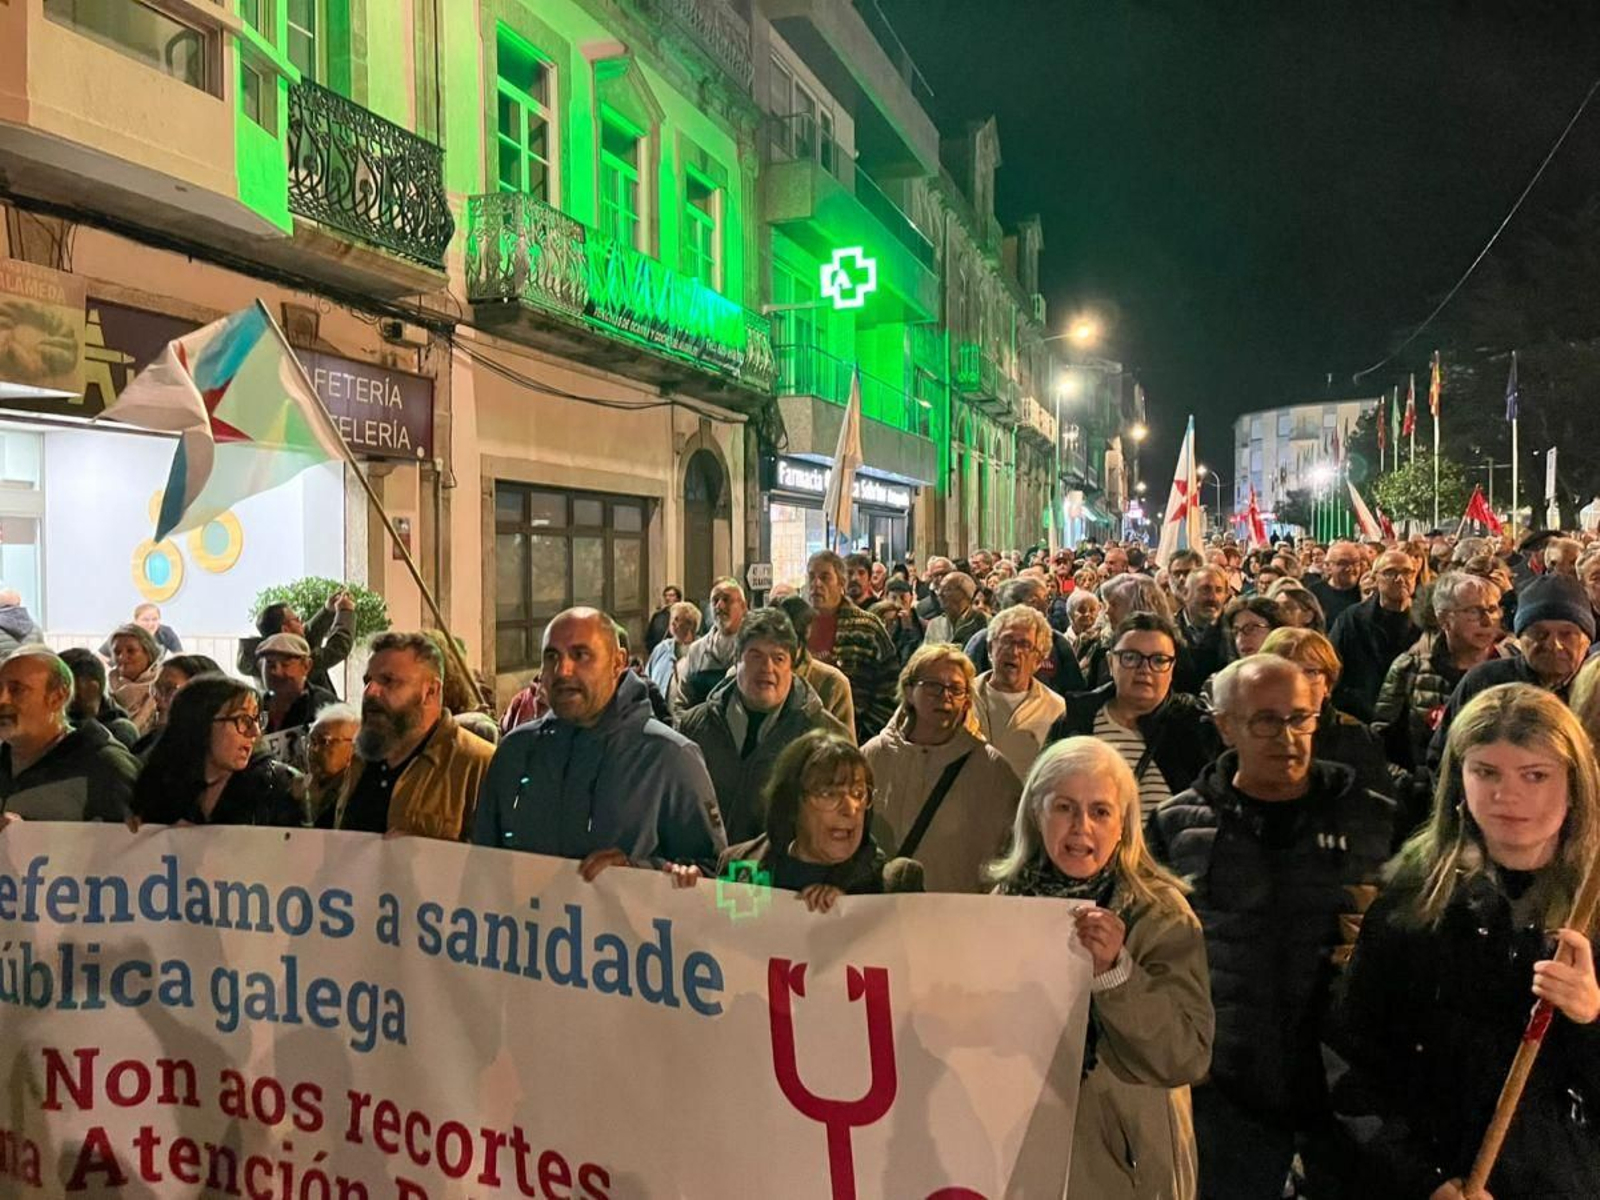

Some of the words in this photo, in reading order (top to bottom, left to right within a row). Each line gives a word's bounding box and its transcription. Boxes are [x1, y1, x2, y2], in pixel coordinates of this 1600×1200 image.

[303, 367, 403, 410] FETERÍA
[210, 954, 408, 1053] galega
[376, 892, 401, 947] a
[416, 896, 725, 1017] sanidade
[40, 1046, 201, 1111] Non
[218, 1066, 325, 1133] aos
[345, 1087, 611, 1200] recortes
